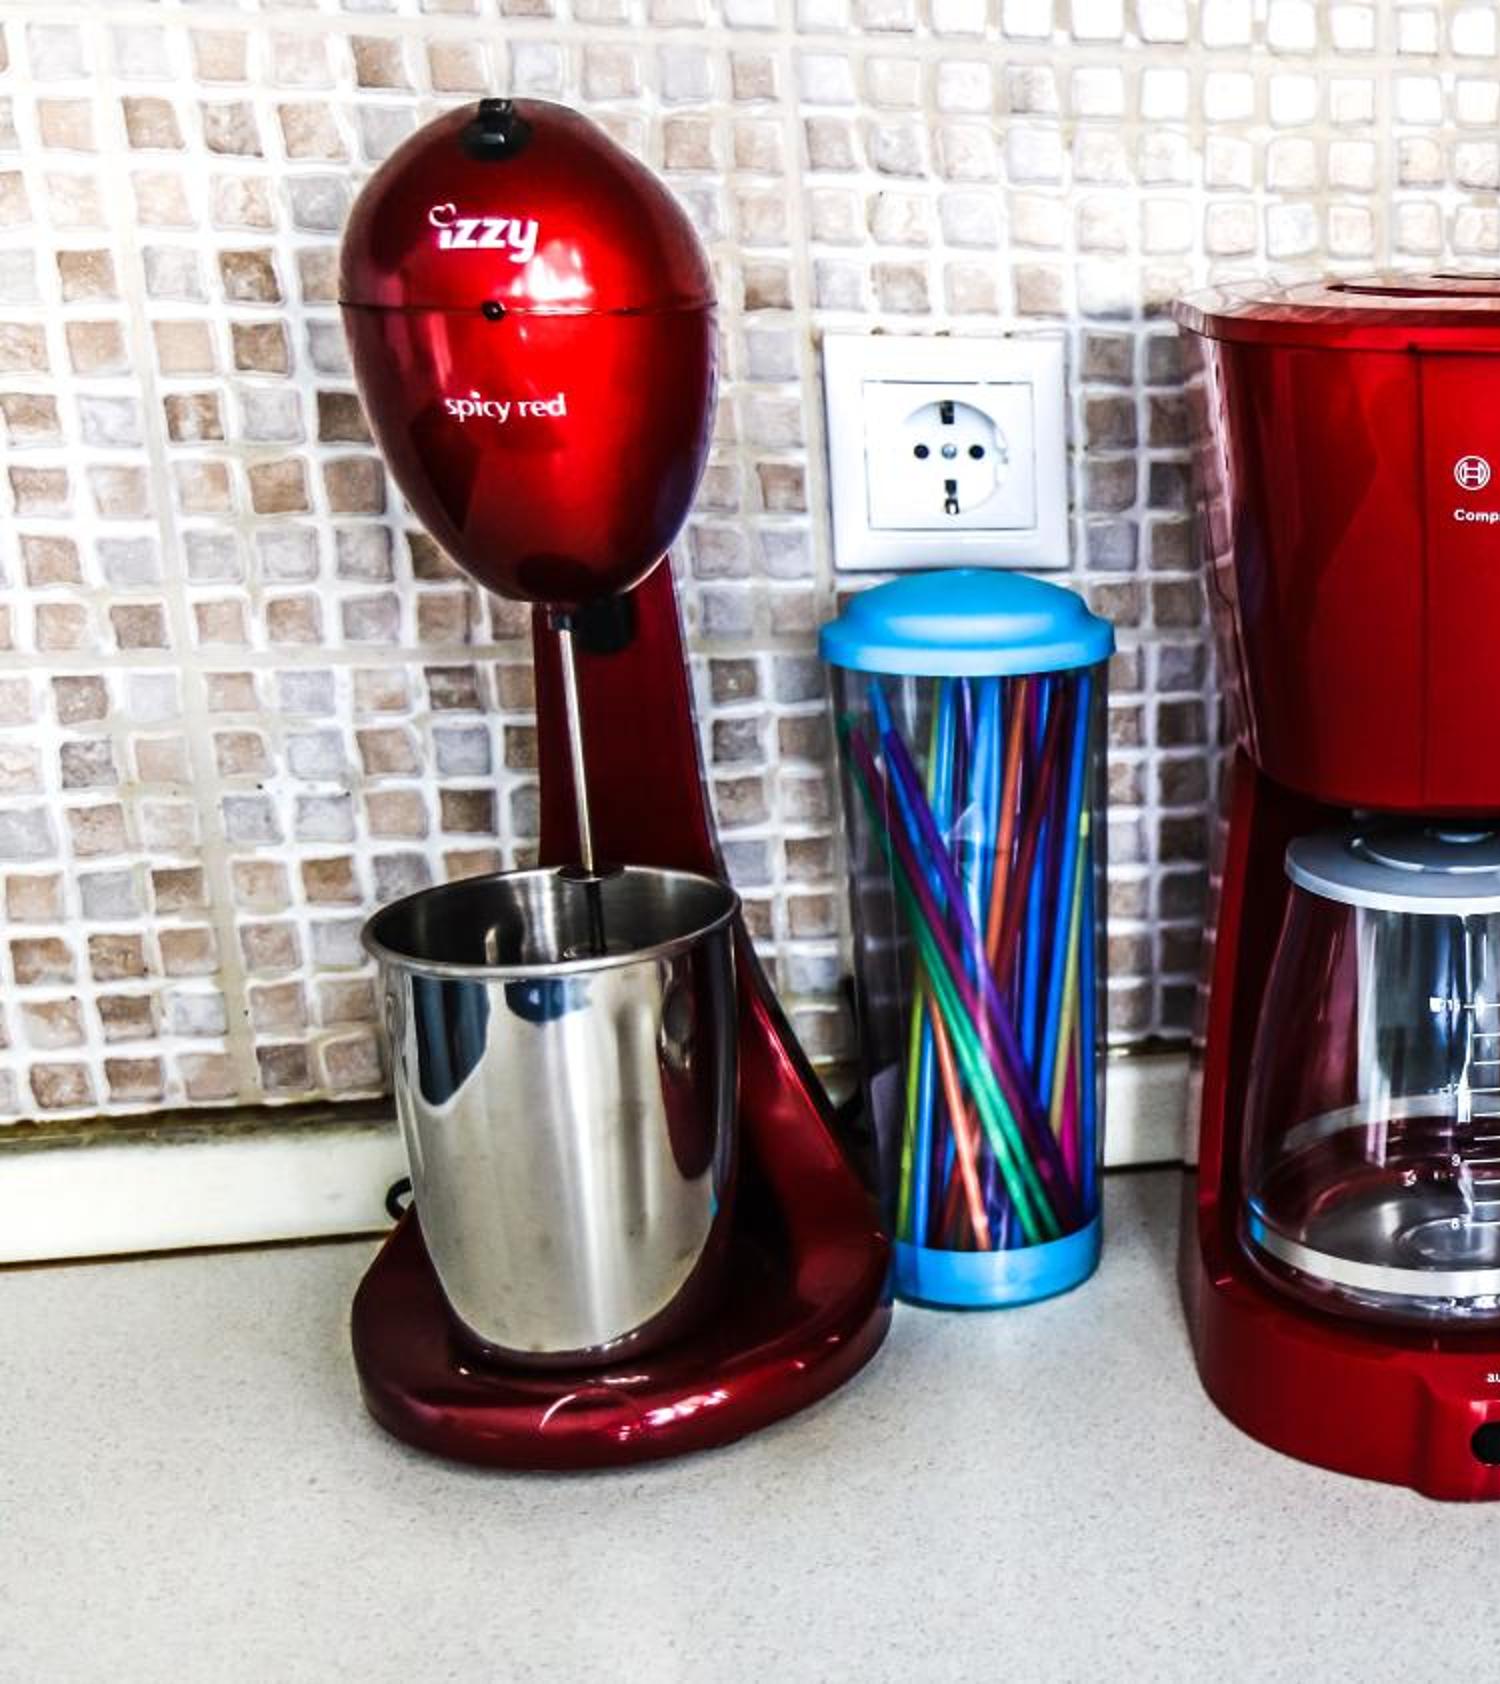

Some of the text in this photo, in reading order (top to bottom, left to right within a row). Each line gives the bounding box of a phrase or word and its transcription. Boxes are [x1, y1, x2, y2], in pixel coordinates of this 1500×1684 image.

[435, 210, 539, 264] izzy
[444, 390, 567, 423] spicy red
